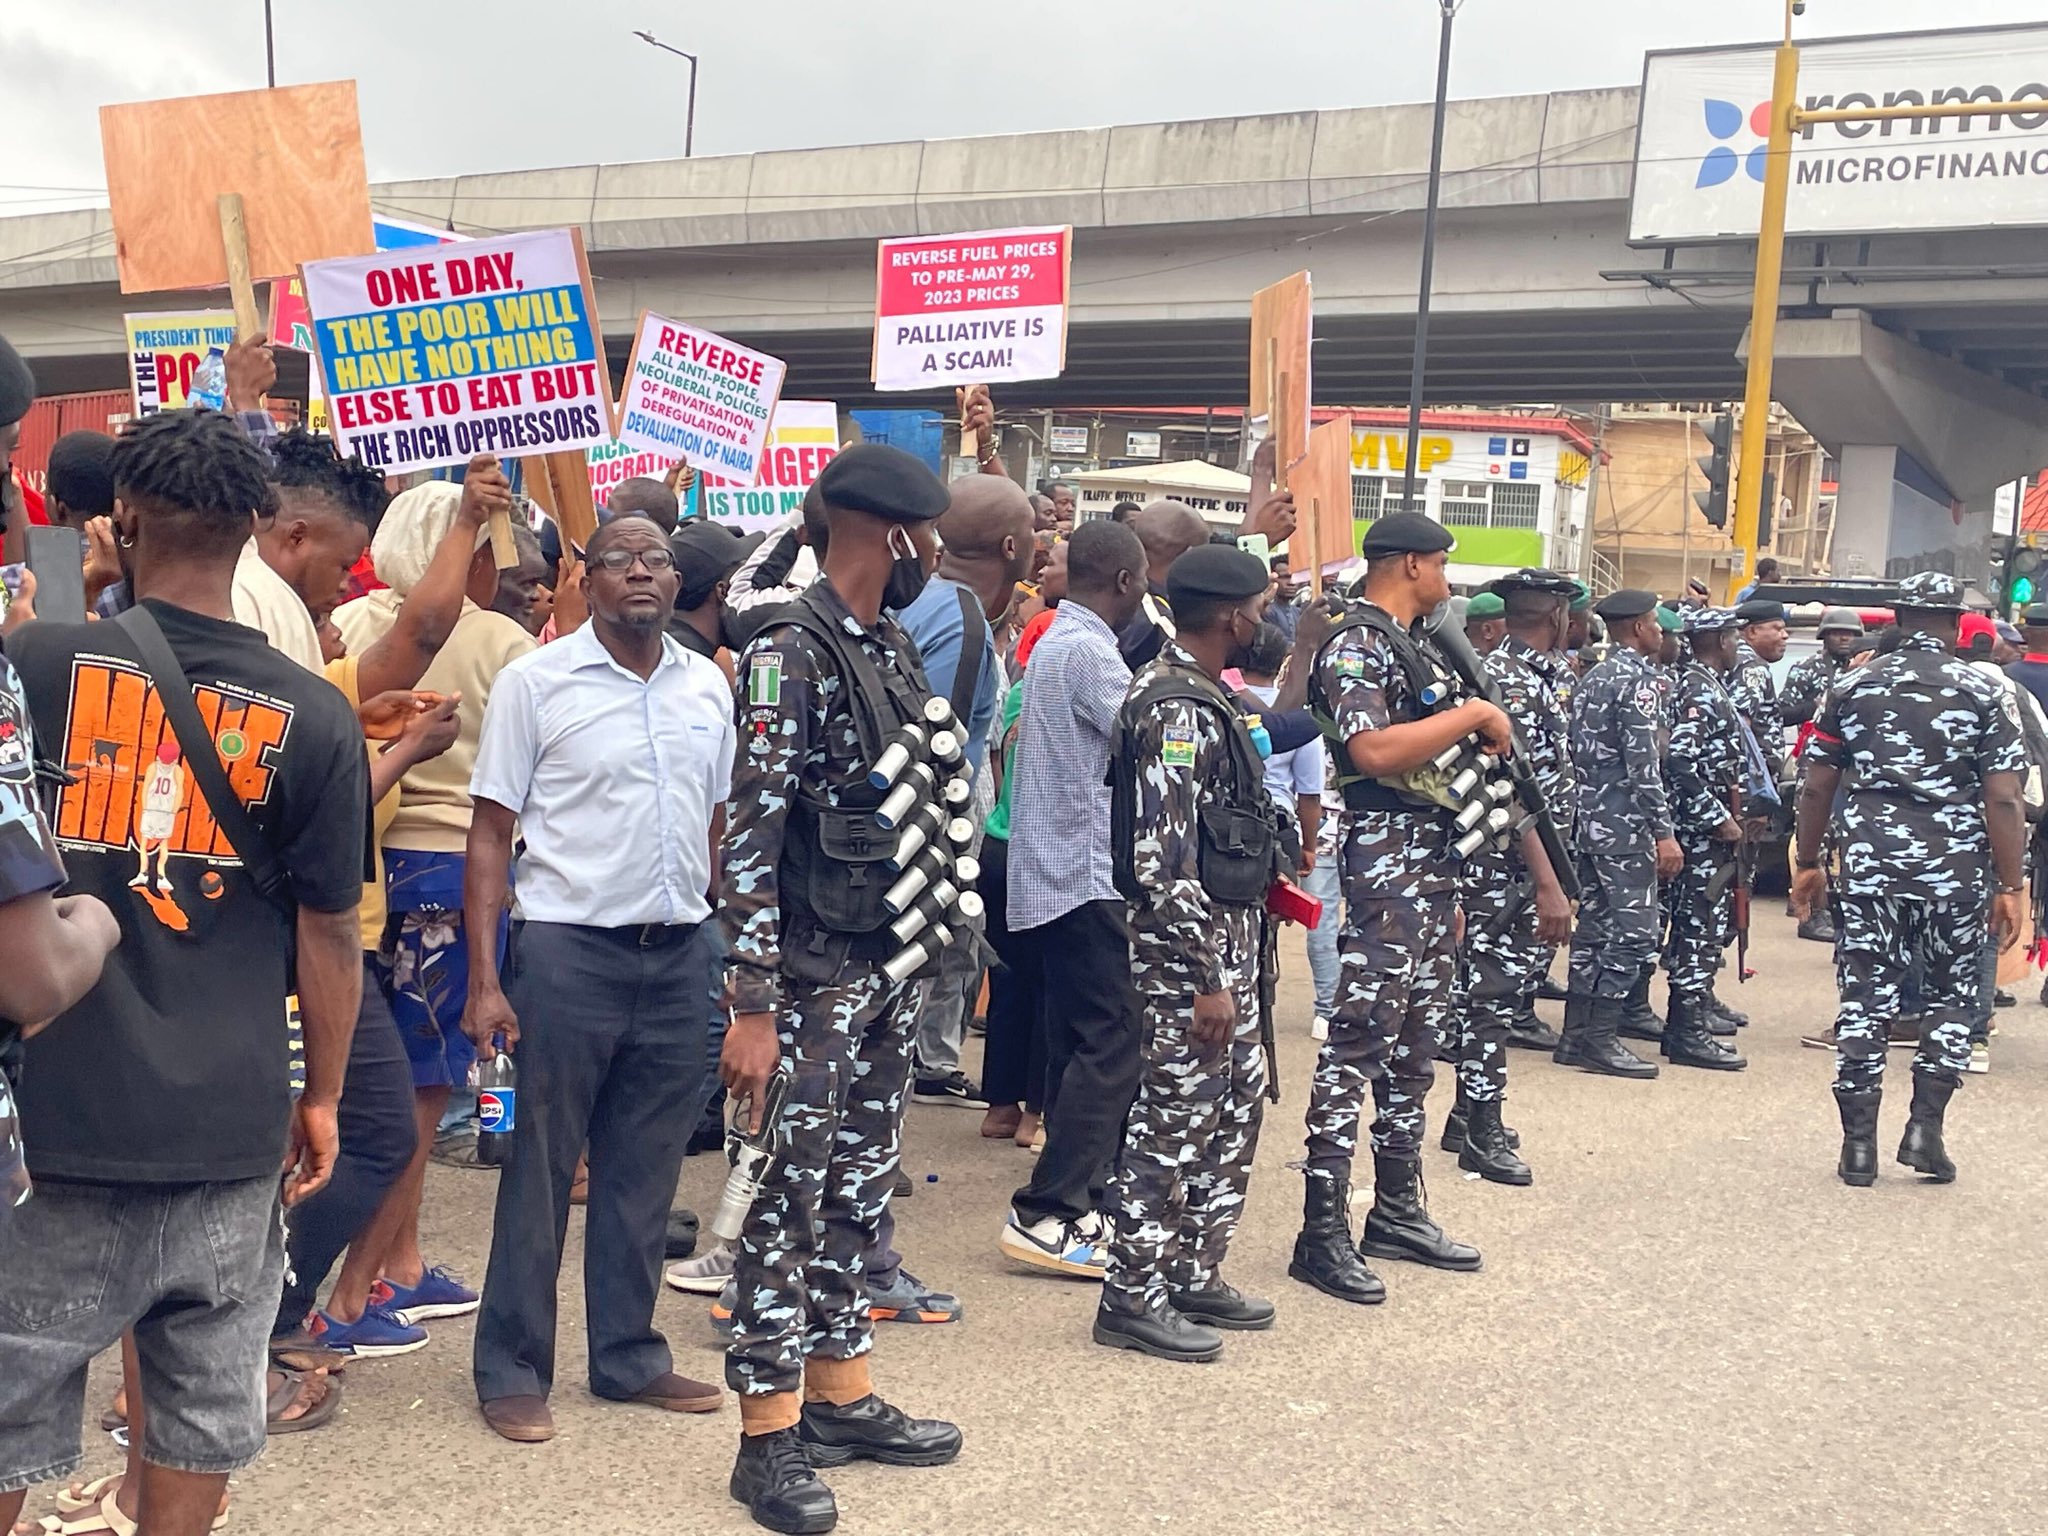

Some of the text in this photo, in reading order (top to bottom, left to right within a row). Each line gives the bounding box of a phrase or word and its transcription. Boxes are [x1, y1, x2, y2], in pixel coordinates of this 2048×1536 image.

[892, 241, 1057, 267] REVERSE FUEL PRICES
[911, 264, 1035, 286] TO PRE-MAY 29,
[365, 252, 523, 307] ONE DAY,
[923, 285, 1020, 306] 2023 PRICES
[135, 326, 236, 348] PRESIDENT TINU
[327, 290, 579, 354] THE POOR WILL
[897, 317, 1044, 346] PALLIATIVE IS
[134, 352, 156, 397] THE
[334, 327, 577, 391] HAVE NOTHING
[651, 351, 760, 403] ALL ANTI-PEOPLE,
[658, 325, 765, 386] REVERSE
[921, 347, 1013, 372] A SCAM!
[336, 363, 597, 429] ELSE TO EAT BUT
[636, 361, 768, 420] NEOLIBERAL POLICIES
[641, 380, 756, 434] OF PRIVATISATION,
[349, 404, 600, 466] THE RICH OPPRESSORS
[626, 411, 753, 473] DEVALUATION OF NAIRA
[641, 397, 748, 446] DEREGULATION &
[708, 492, 730, 516] IS
[733, 491, 774, 516] TOO
[1083, 490, 1146, 503] TRAFFIC OFFICER
[154, 777, 171, 795] 10
